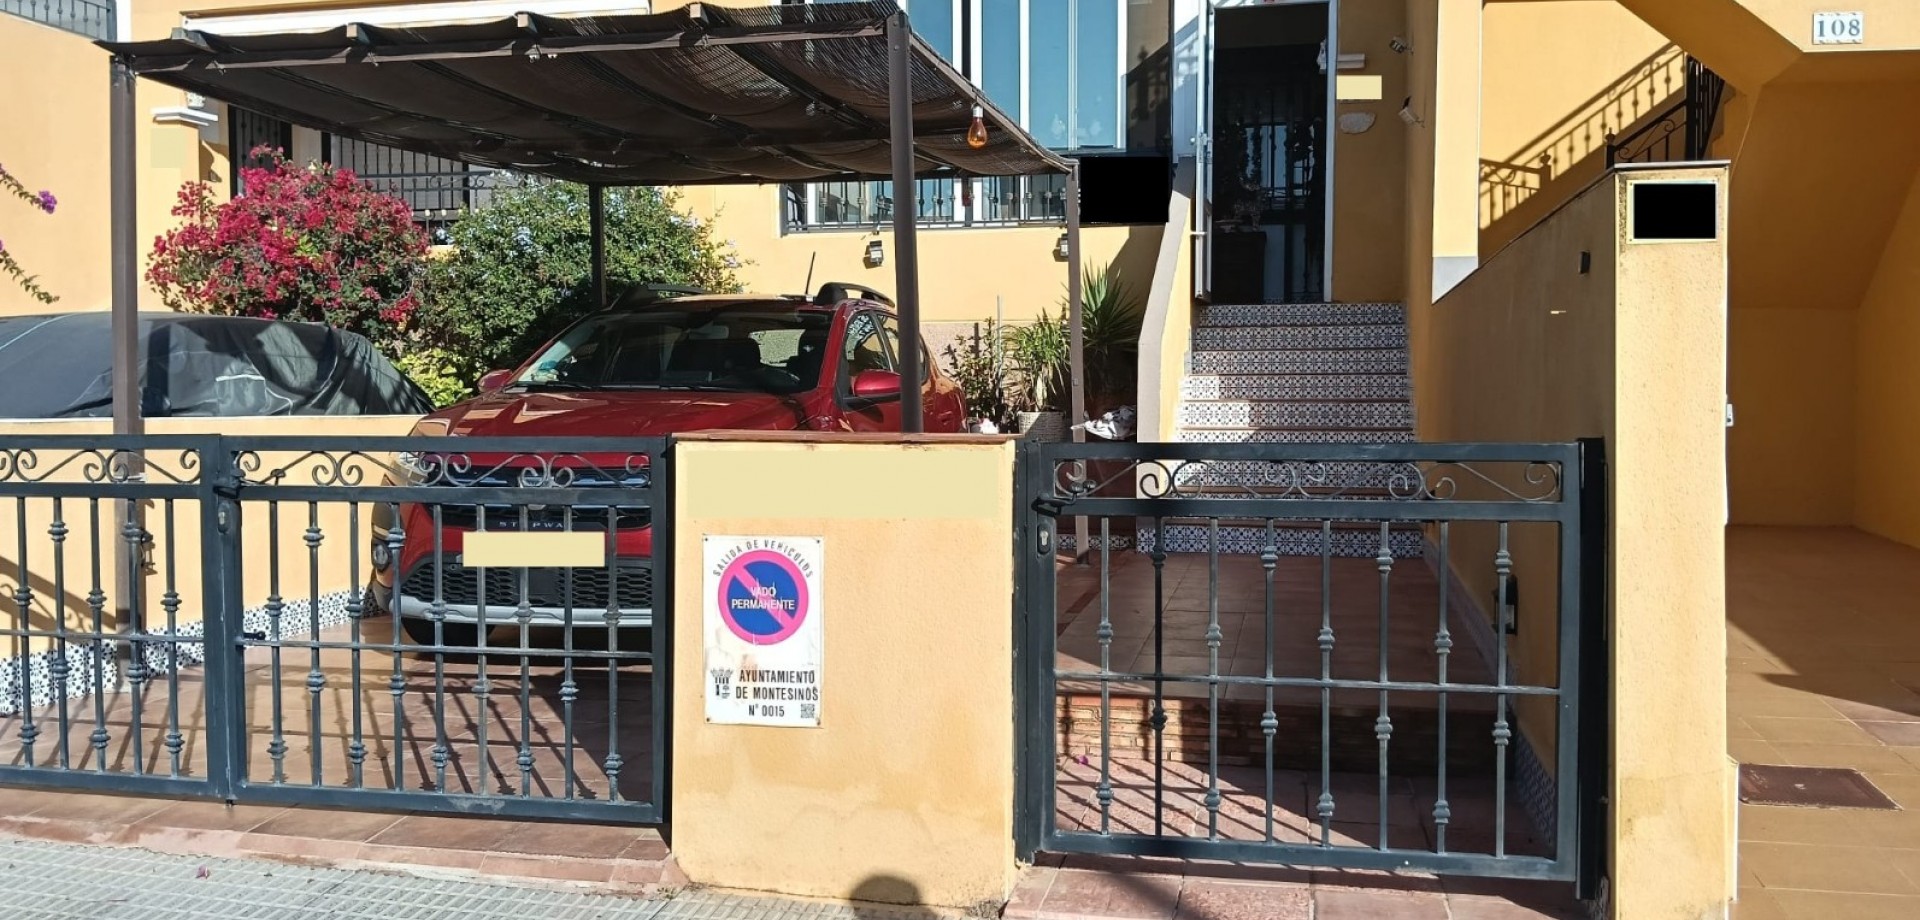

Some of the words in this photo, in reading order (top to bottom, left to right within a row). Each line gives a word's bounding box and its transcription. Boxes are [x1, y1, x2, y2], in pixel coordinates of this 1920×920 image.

[1818, 19, 1860, 37] 108
[713, 545, 743, 576] SALIDA
[746, 540, 759, 550] DE
[750, 586, 777, 597] VADO
[731, 598, 795, 610] PERMANENTE
[739, 669, 815, 684] AYUNTAMIENTO
[735, 686, 748, 699] DE
[753, 686, 818, 701] MONTESINOS
[761, 704, 785, 717] 0015
